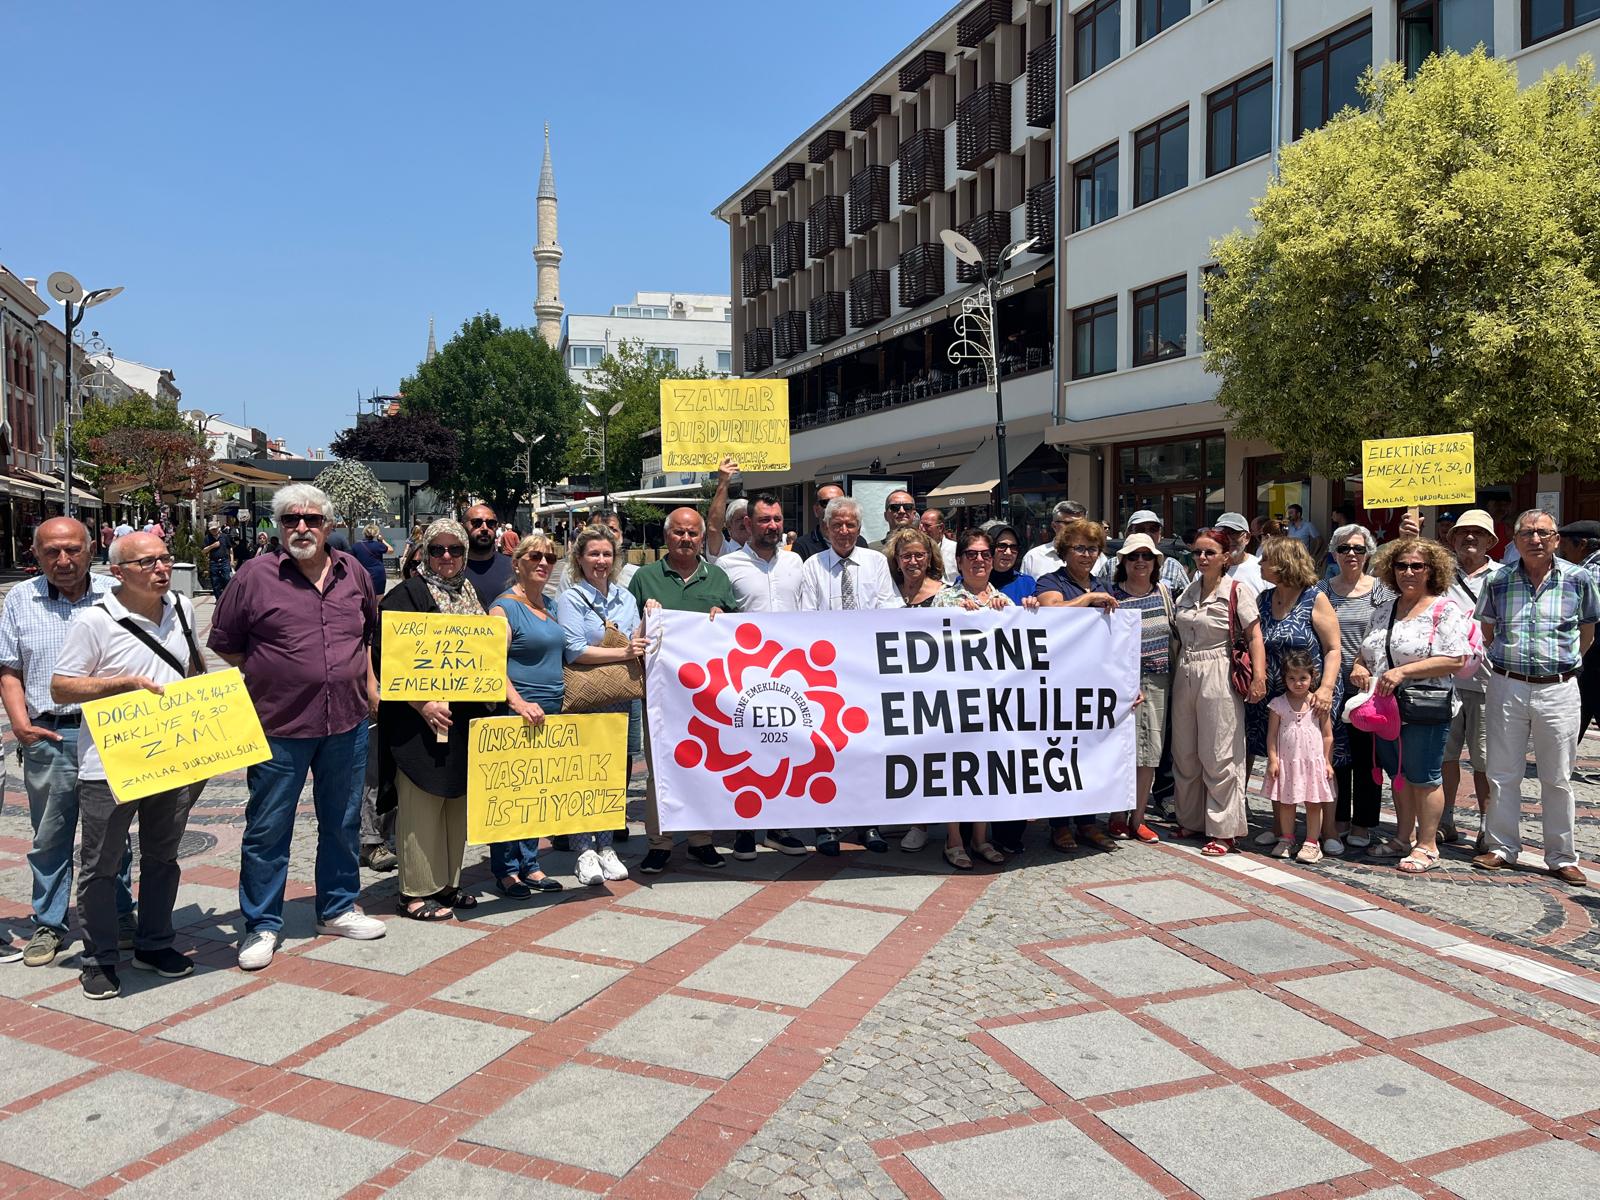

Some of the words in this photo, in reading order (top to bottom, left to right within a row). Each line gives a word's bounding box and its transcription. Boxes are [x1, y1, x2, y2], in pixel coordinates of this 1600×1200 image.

[673, 385, 775, 411] ZAMLAR
[666, 418, 788, 444] DURDURULSUN
[1367, 459, 1431, 477] EMEKLİYE
[1367, 496, 1406, 505] ZAMLAR
[392, 616, 428, 637] VERGİ
[444, 625, 494, 637] HARÇLARA
[876, 618, 1050, 675] EDİRNE
[388, 672, 470, 692] EMEKLİYE
[97, 702, 154, 727] DOĞAL
[734, 696, 749, 728] EDİRNE
[745, 681, 791, 699] EMEKLİLER
[752, 706, 796, 728] EED
[880, 676, 1117, 736] EMEKLİLER
[103, 715, 183, 749] EMEKLİYE
[478, 723, 579, 754] İNSANCA
[760, 732, 788, 743] 2025
[121, 764, 181, 788] ZAMLAR
[478, 753, 612, 792] YAŞAMAK
[885, 736, 1084, 799] DERNEĞİ
[485, 787, 626, 827] İSTİYORUZ
